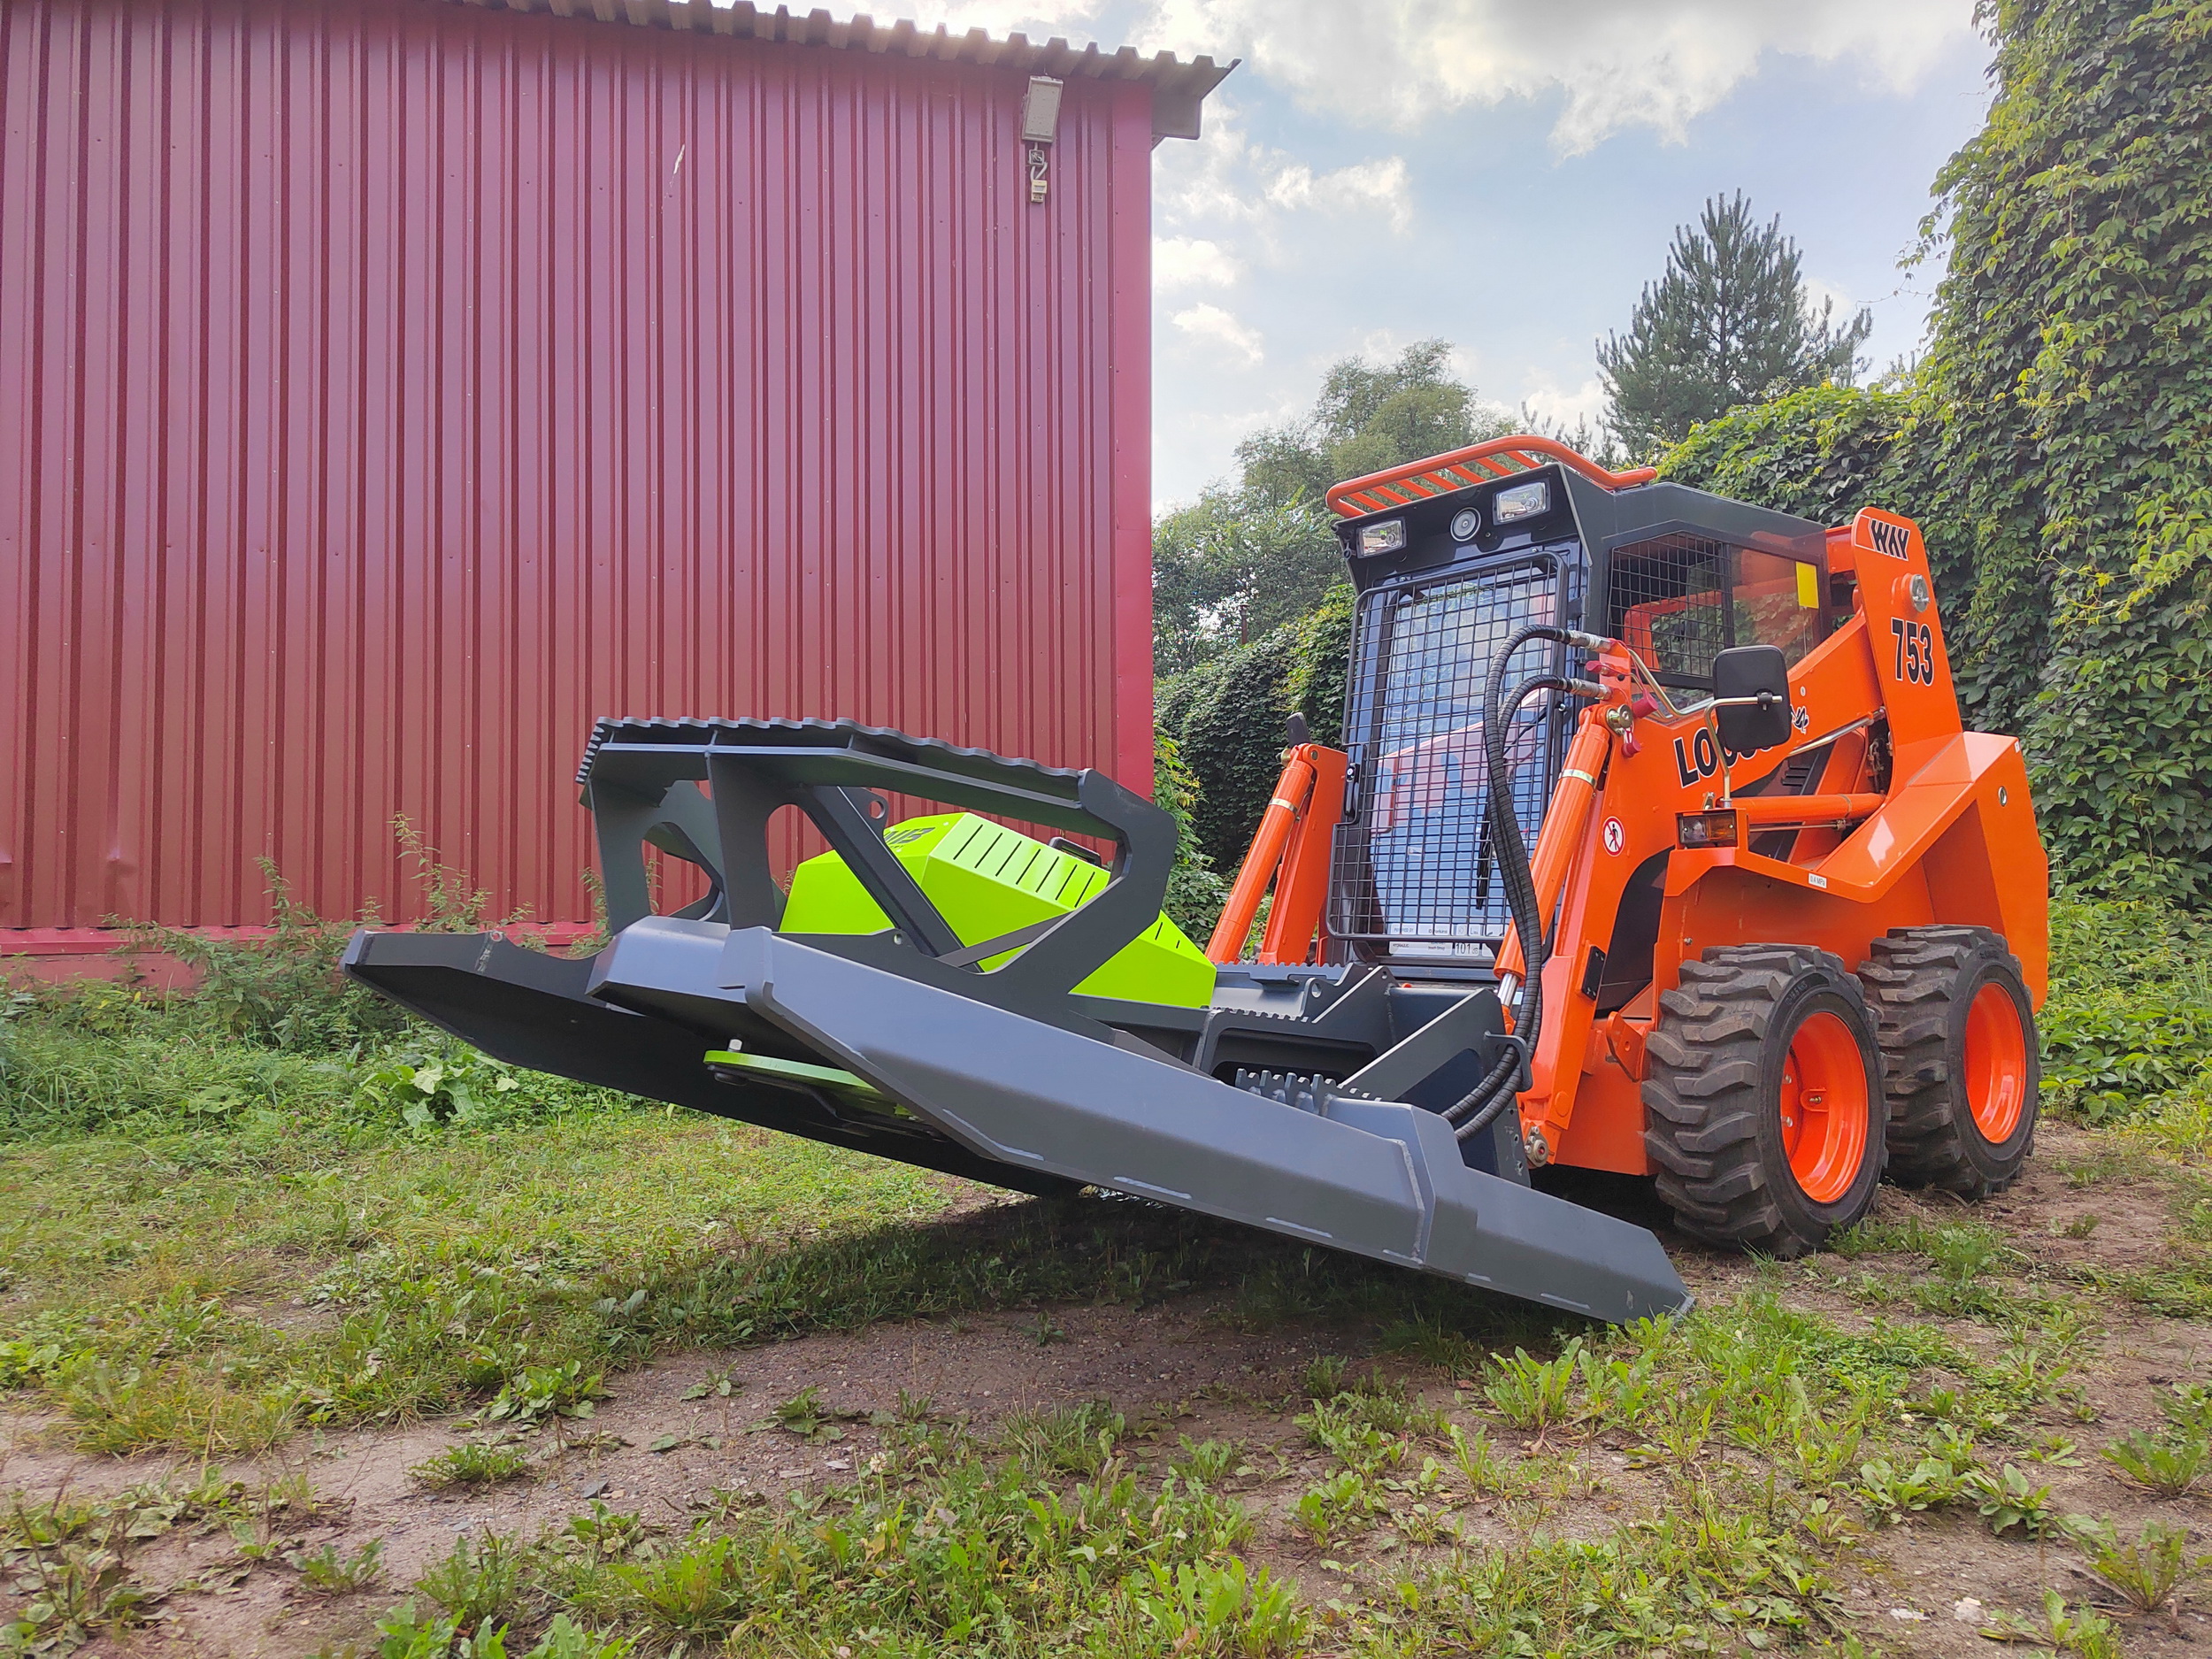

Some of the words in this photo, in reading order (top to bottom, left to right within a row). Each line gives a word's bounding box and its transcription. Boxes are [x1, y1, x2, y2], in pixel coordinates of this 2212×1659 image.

[1870, 518, 1911, 561] WAY
[1891, 617, 1934, 687] 753
[1455, 943, 1471, 955] 101
